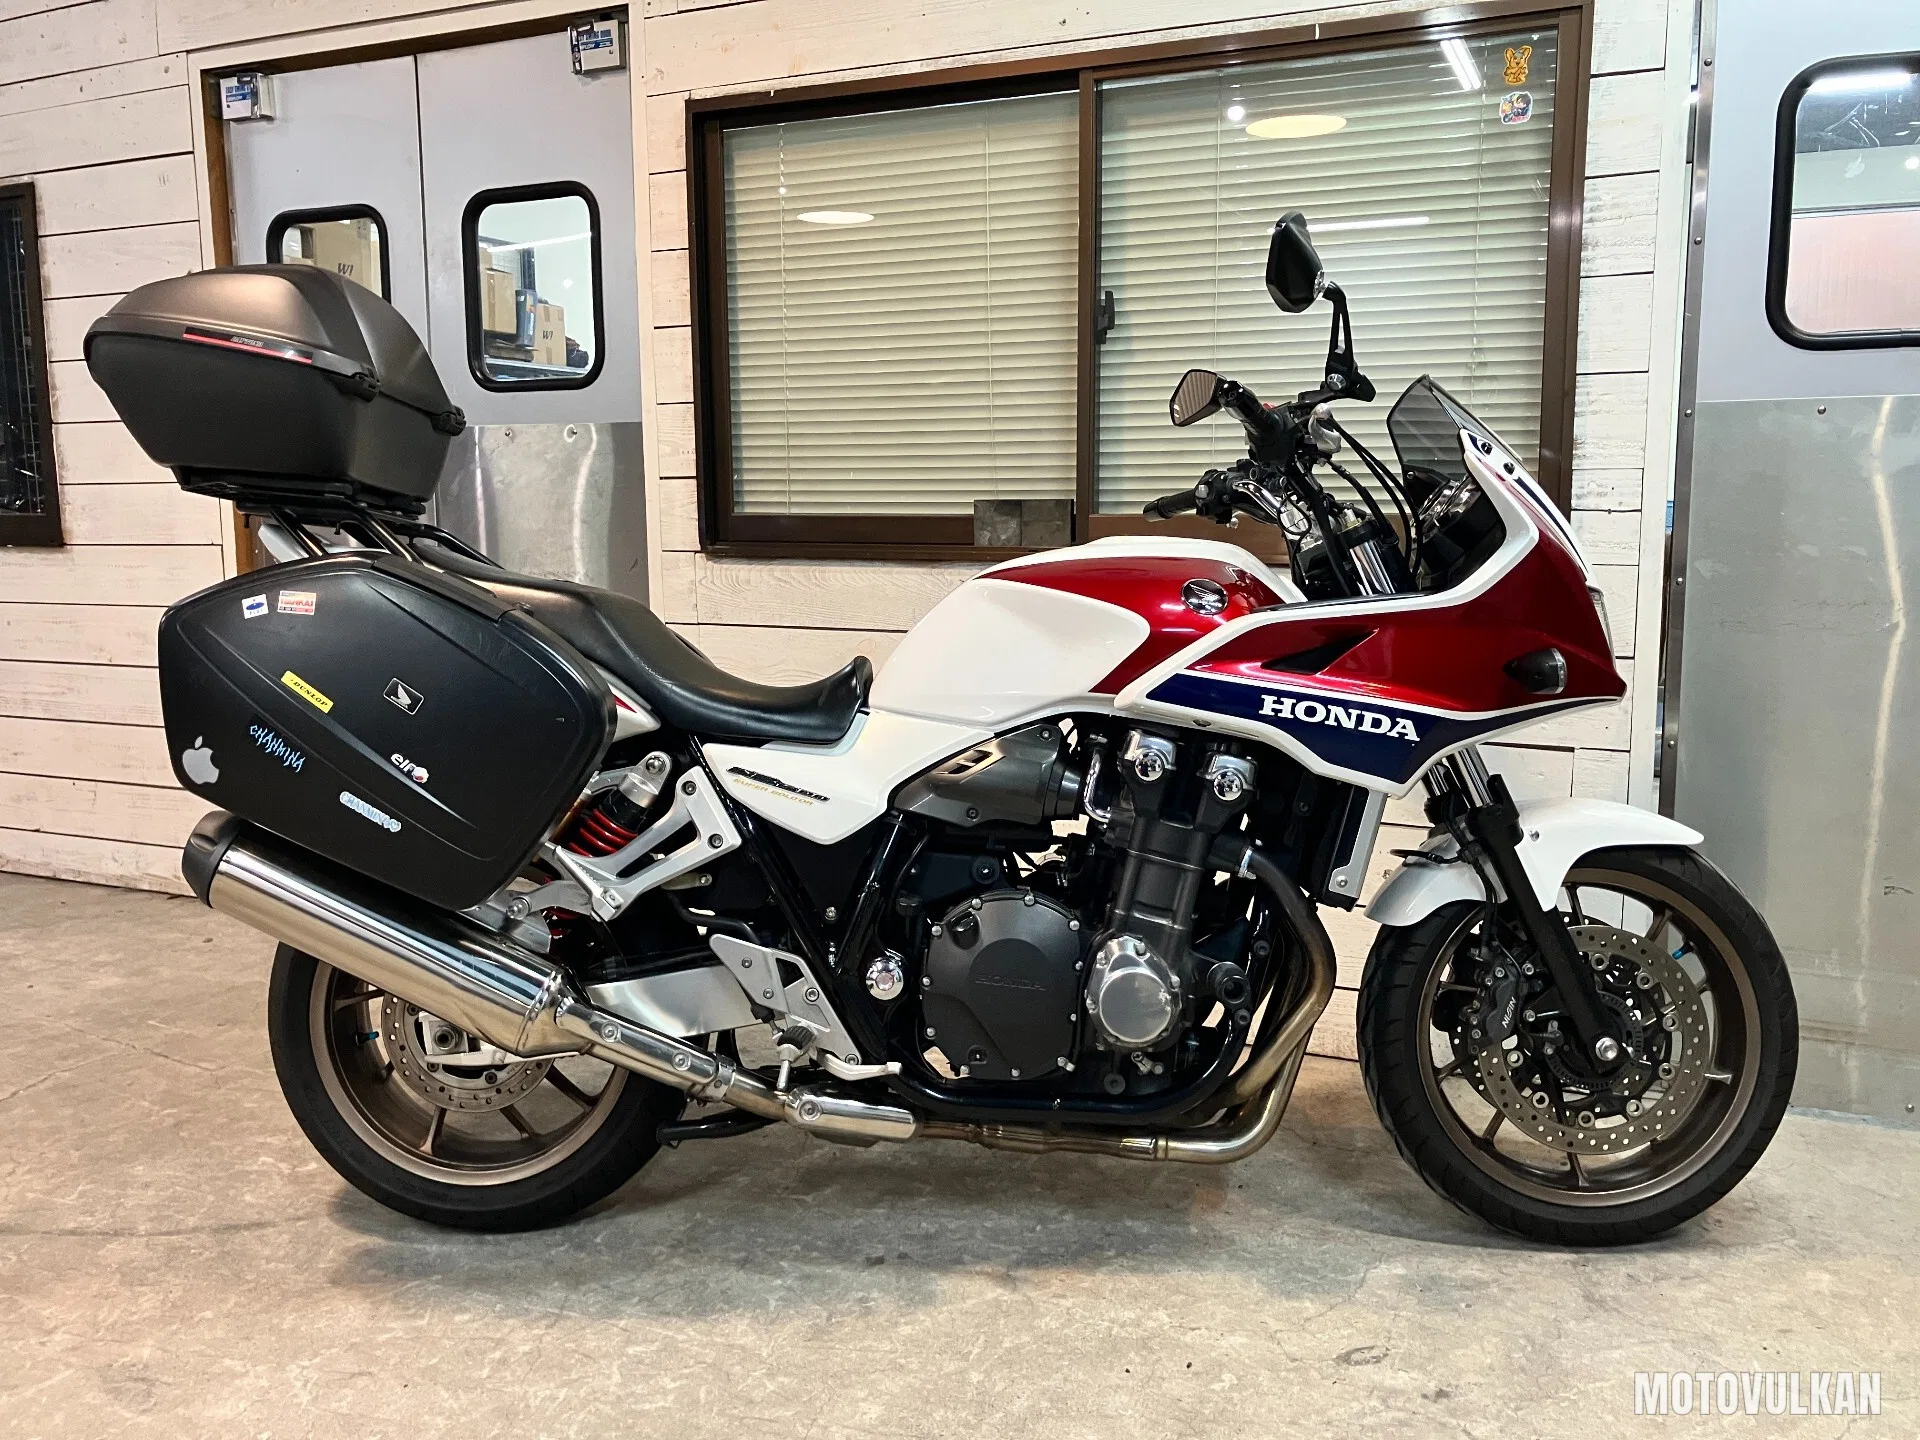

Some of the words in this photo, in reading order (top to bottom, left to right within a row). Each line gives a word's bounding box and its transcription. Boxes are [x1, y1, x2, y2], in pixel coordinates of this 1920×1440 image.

[291, 680, 329, 707] DUNLOP
[1258, 694, 1421, 742] HONDA
[732, 778, 768, 792] SUPER
[974, 975, 1047, 991] HONDA
